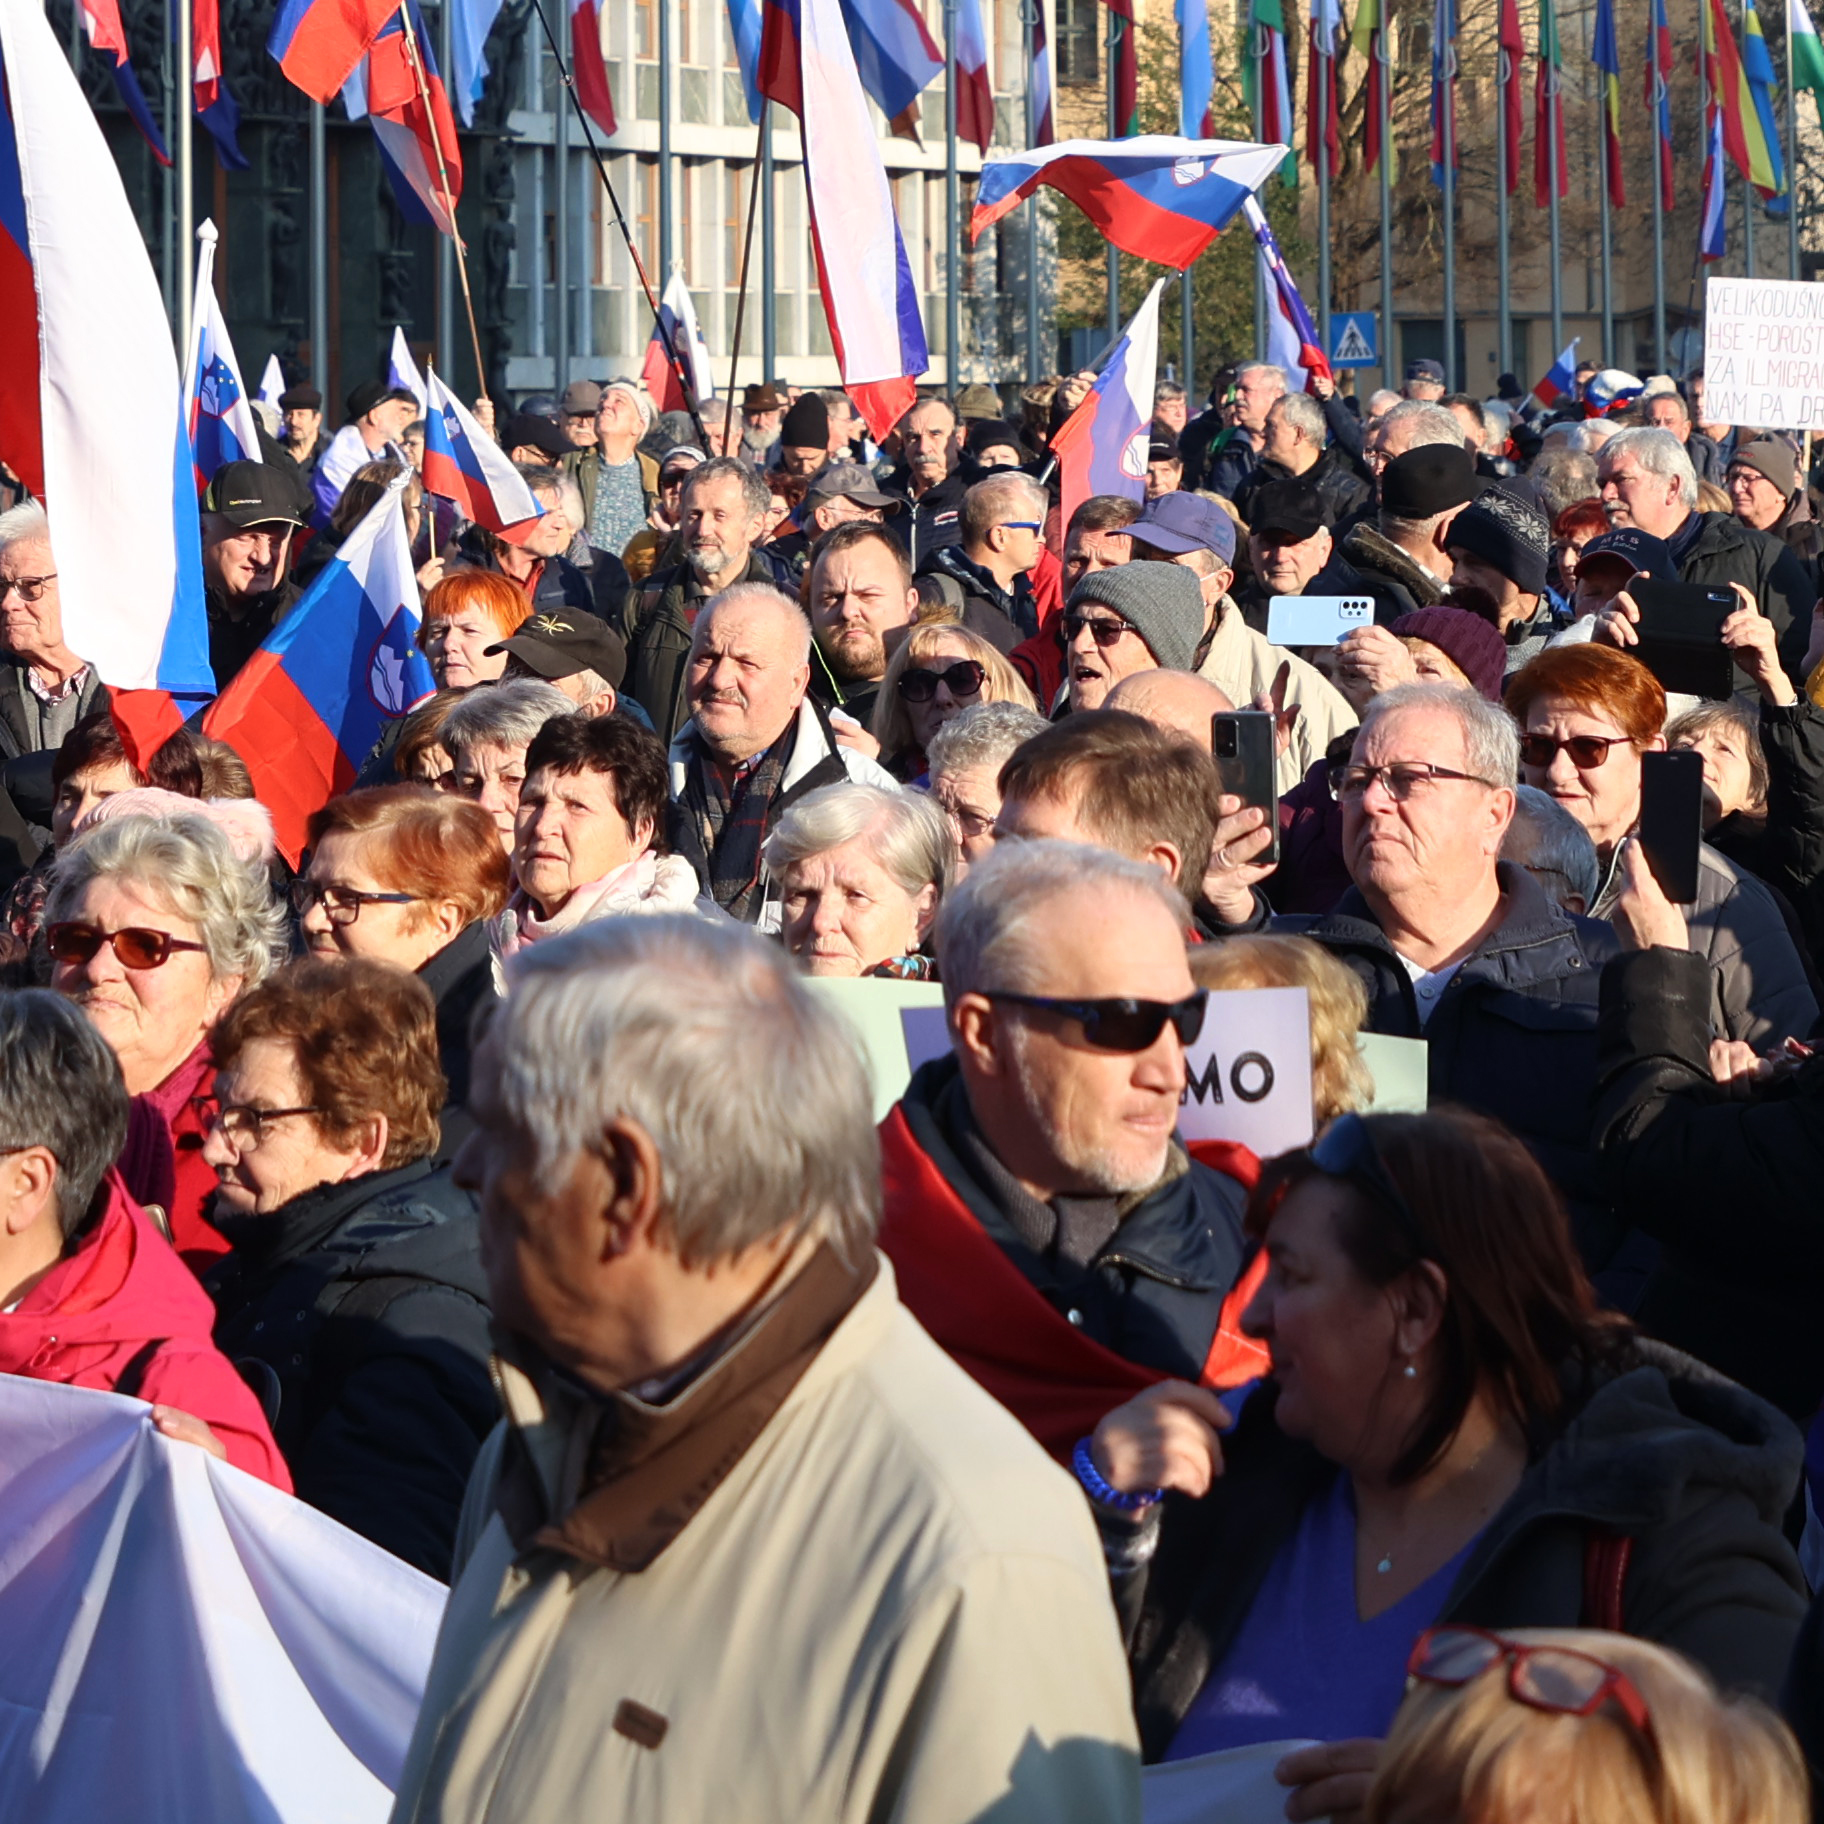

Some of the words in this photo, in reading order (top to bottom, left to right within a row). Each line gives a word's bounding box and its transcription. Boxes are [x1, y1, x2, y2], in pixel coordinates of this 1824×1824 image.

[1708, 356, 1736, 386] ZA
[1704, 389, 1747, 421] NAM
[1758, 392, 1785, 423] PA
